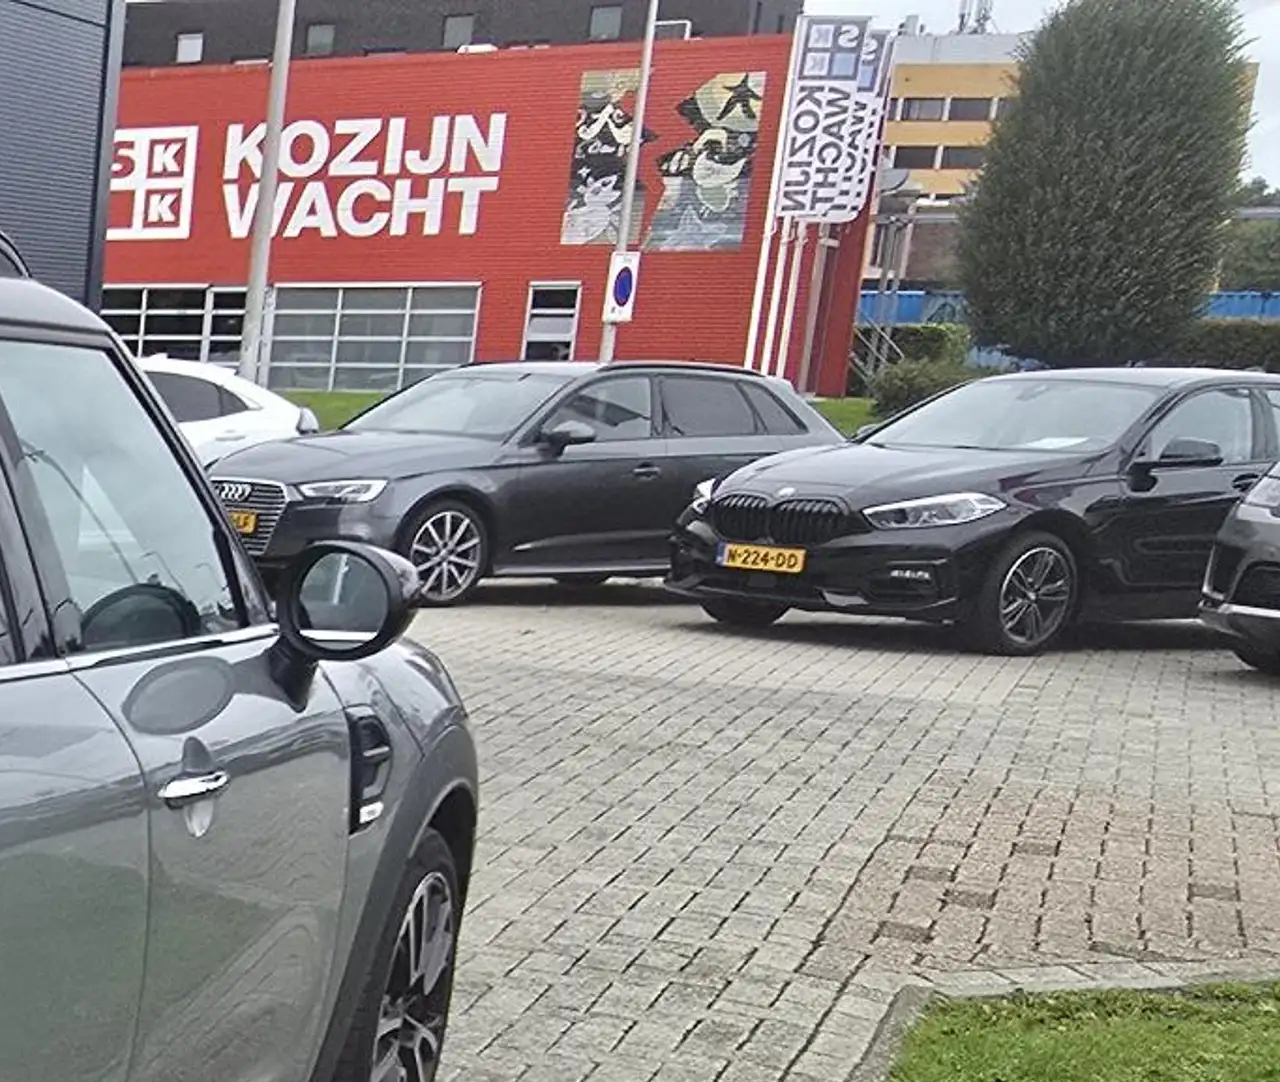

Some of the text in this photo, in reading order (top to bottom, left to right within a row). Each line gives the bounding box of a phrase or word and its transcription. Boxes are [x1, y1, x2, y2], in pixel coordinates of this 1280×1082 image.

[151, 142, 184, 174] K
[223, 112, 507, 180] KOZIJN
[146, 192, 179, 223] K
